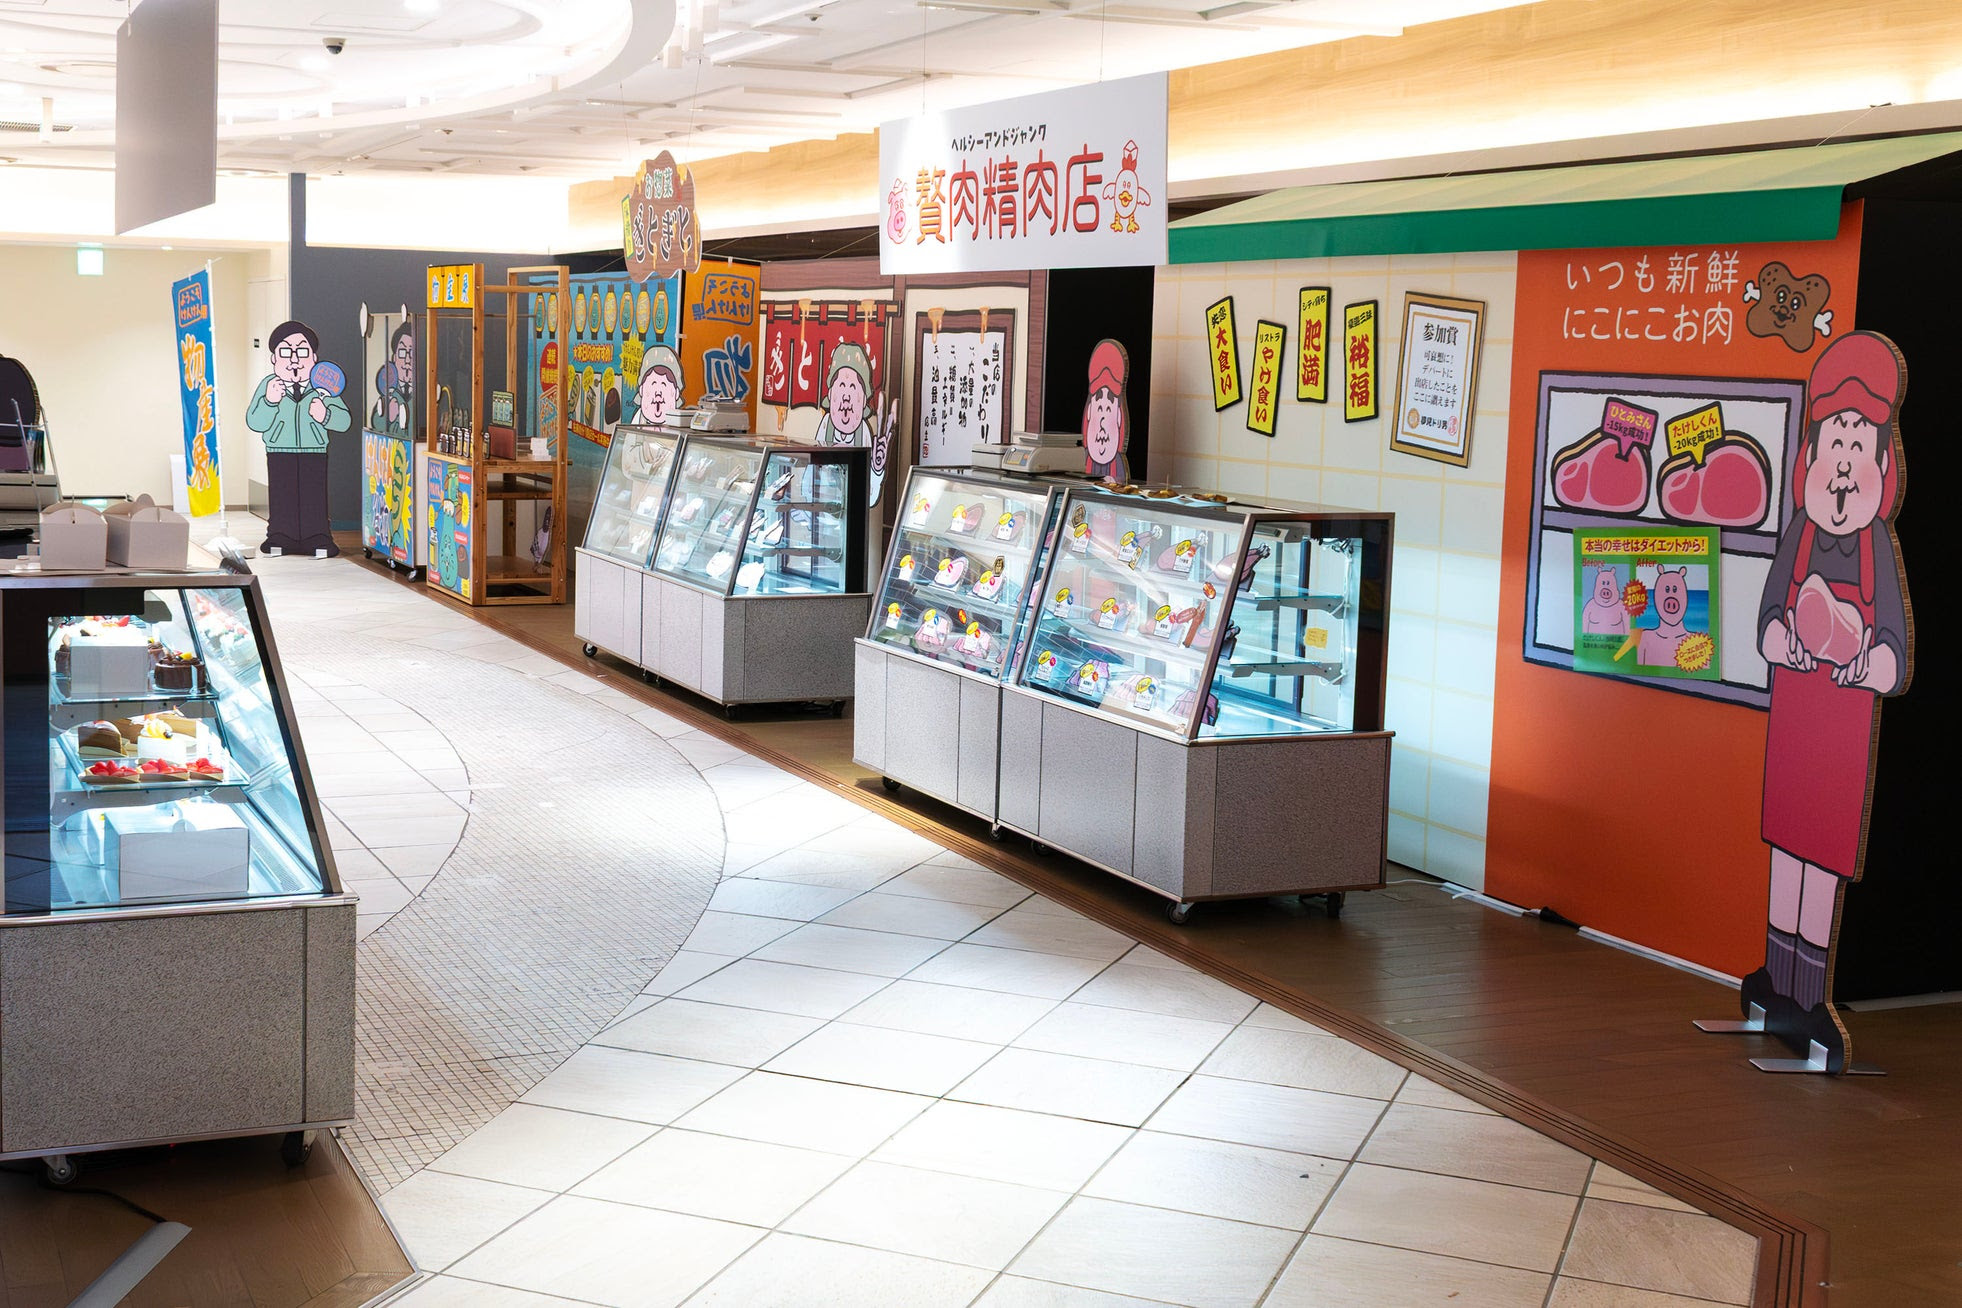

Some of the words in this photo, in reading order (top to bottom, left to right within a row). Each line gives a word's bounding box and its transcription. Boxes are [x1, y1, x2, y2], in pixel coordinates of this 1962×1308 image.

[951, 124, 1047, 152] ヘルシーアンドジャンク
[915, 143, 1104, 246] 贅肉精肉店
[1566, 250, 1740, 294] いつも新鮮
[1259, 332, 1281, 343] リストラ
[1423, 323, 1459, 346] 参加賞
[1562, 301, 1733, 345] にこにこお肉
[1216, 327, 1232, 396] 大食い
[1301, 318, 1322, 387] 肥満
[1349, 333, 1370, 408] 裕福
[1255, 346, 1275, 423] やけ食い
[180, 333, 215, 492] 物産展
[1606, 419, 1649, 442] -15kg成功！
[1609, 404, 1652, 429] ひとみさん
[1672, 411, 1718, 438] たけしくん
[1673, 426, 1720, 450] -20kg成功！
[1584, 538, 1706, 553] 本当の幸せはダイエットから！
